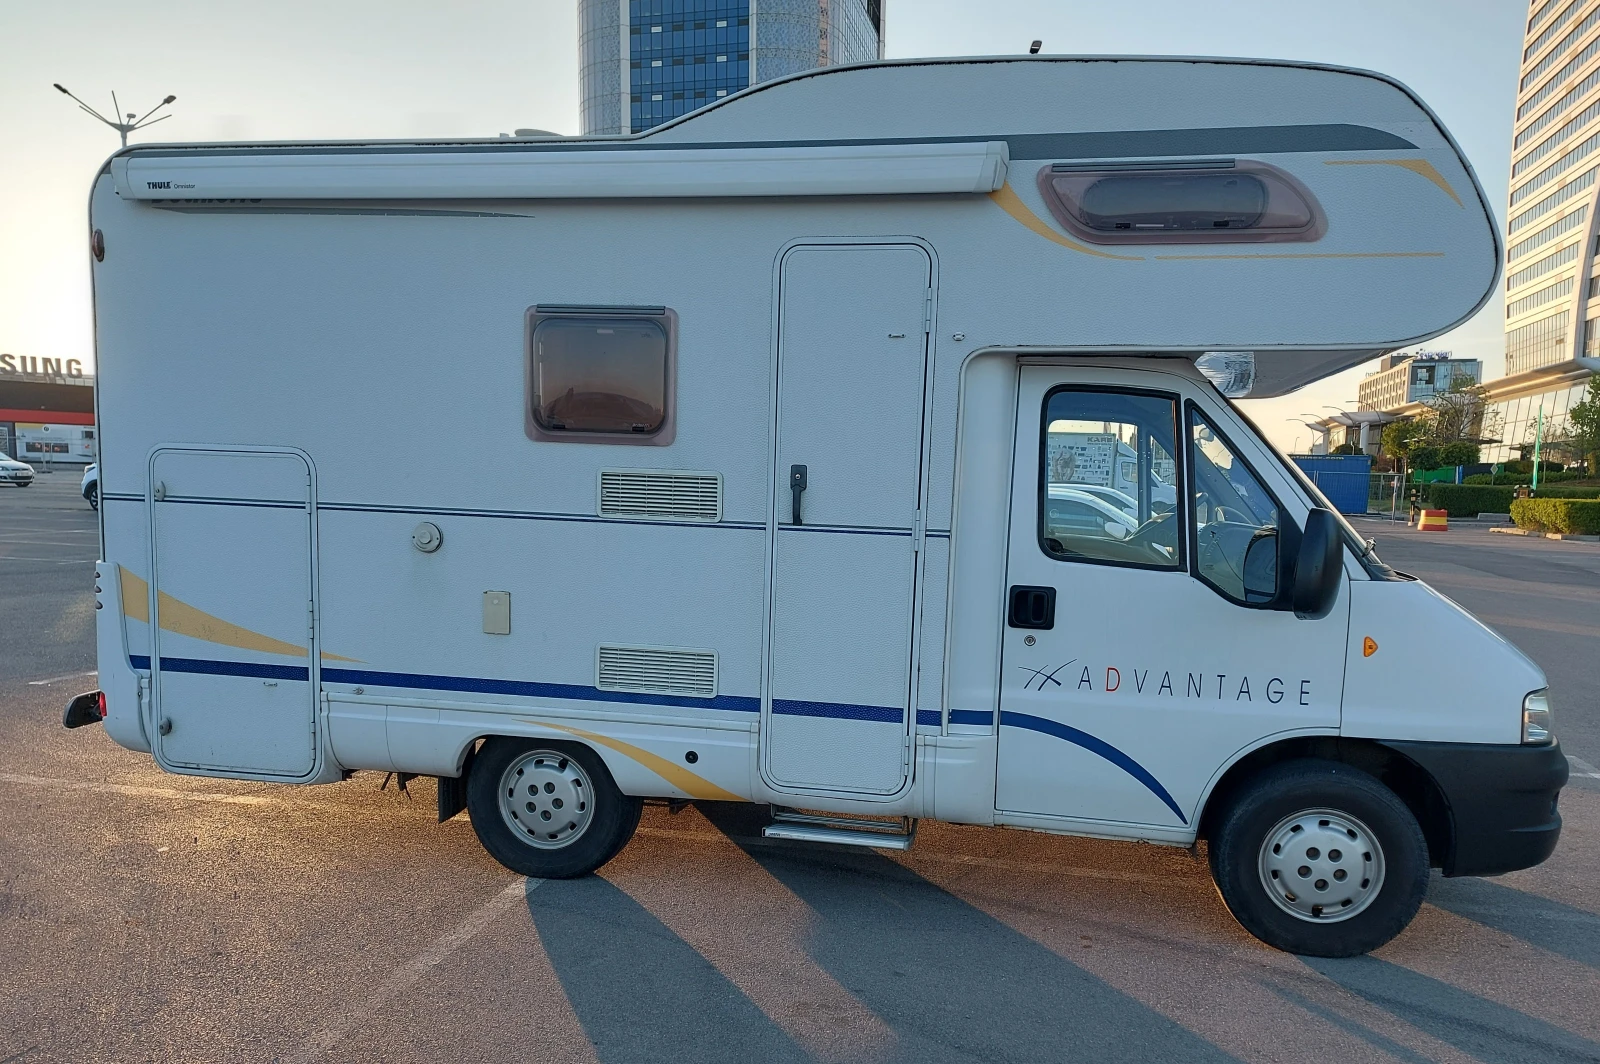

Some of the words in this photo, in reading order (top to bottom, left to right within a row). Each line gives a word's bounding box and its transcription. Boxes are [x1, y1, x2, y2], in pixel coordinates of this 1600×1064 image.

[146, 181, 172, 190] THULE
[0, 353, 83, 379] SUNG
[1077, 665, 1311, 706] ADVANTAGE
